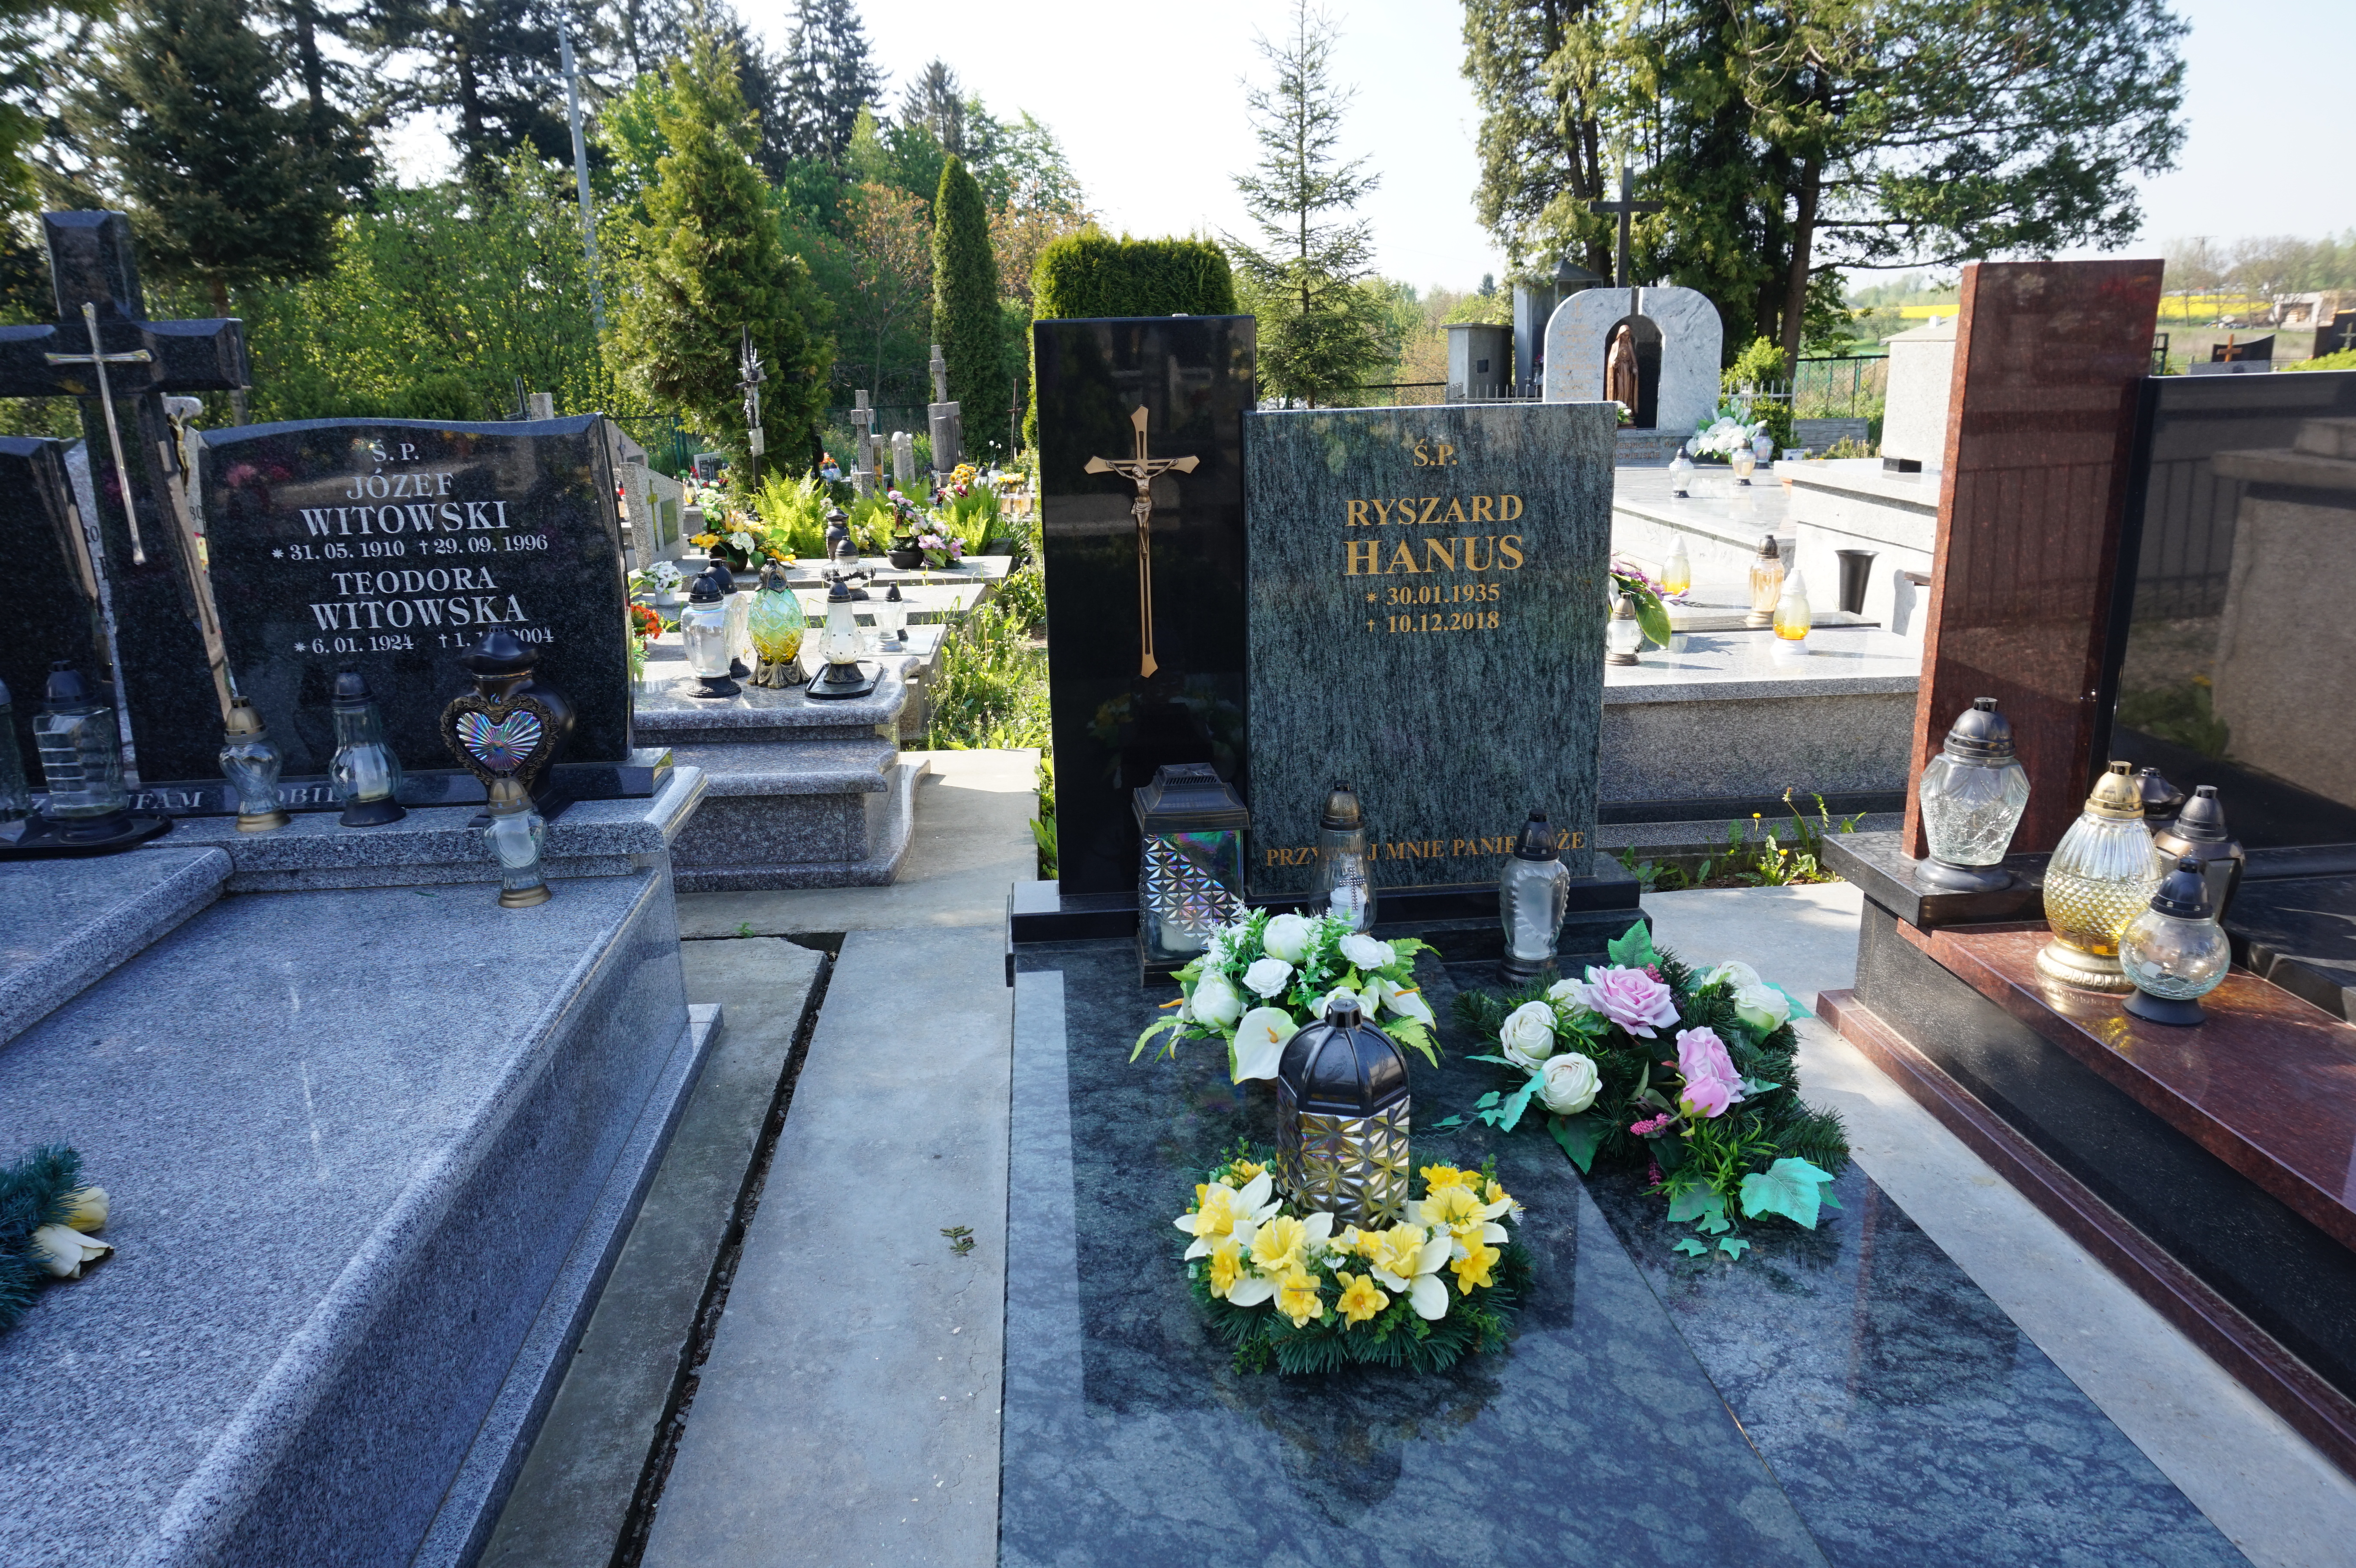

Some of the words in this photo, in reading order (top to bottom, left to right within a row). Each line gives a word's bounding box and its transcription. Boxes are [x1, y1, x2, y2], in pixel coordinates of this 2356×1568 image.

[346, 468, 454, 499] JÓZEF
[300, 501, 510, 537] WITOWSKI
[1344, 494, 1523, 527] RYSZARD
[1343, 534, 1524, 576] HANUS
[331, 566, 499, 595] TEODORA
[1387, 583, 1500, 605] 30.01.1935
[309, 593, 529, 631] WITOWSKA
[1388, 611, 1500, 633] 10.12.2018
[1385, 840, 1445, 860] MNIE
[1452, 836, 1517, 857] PANIE
